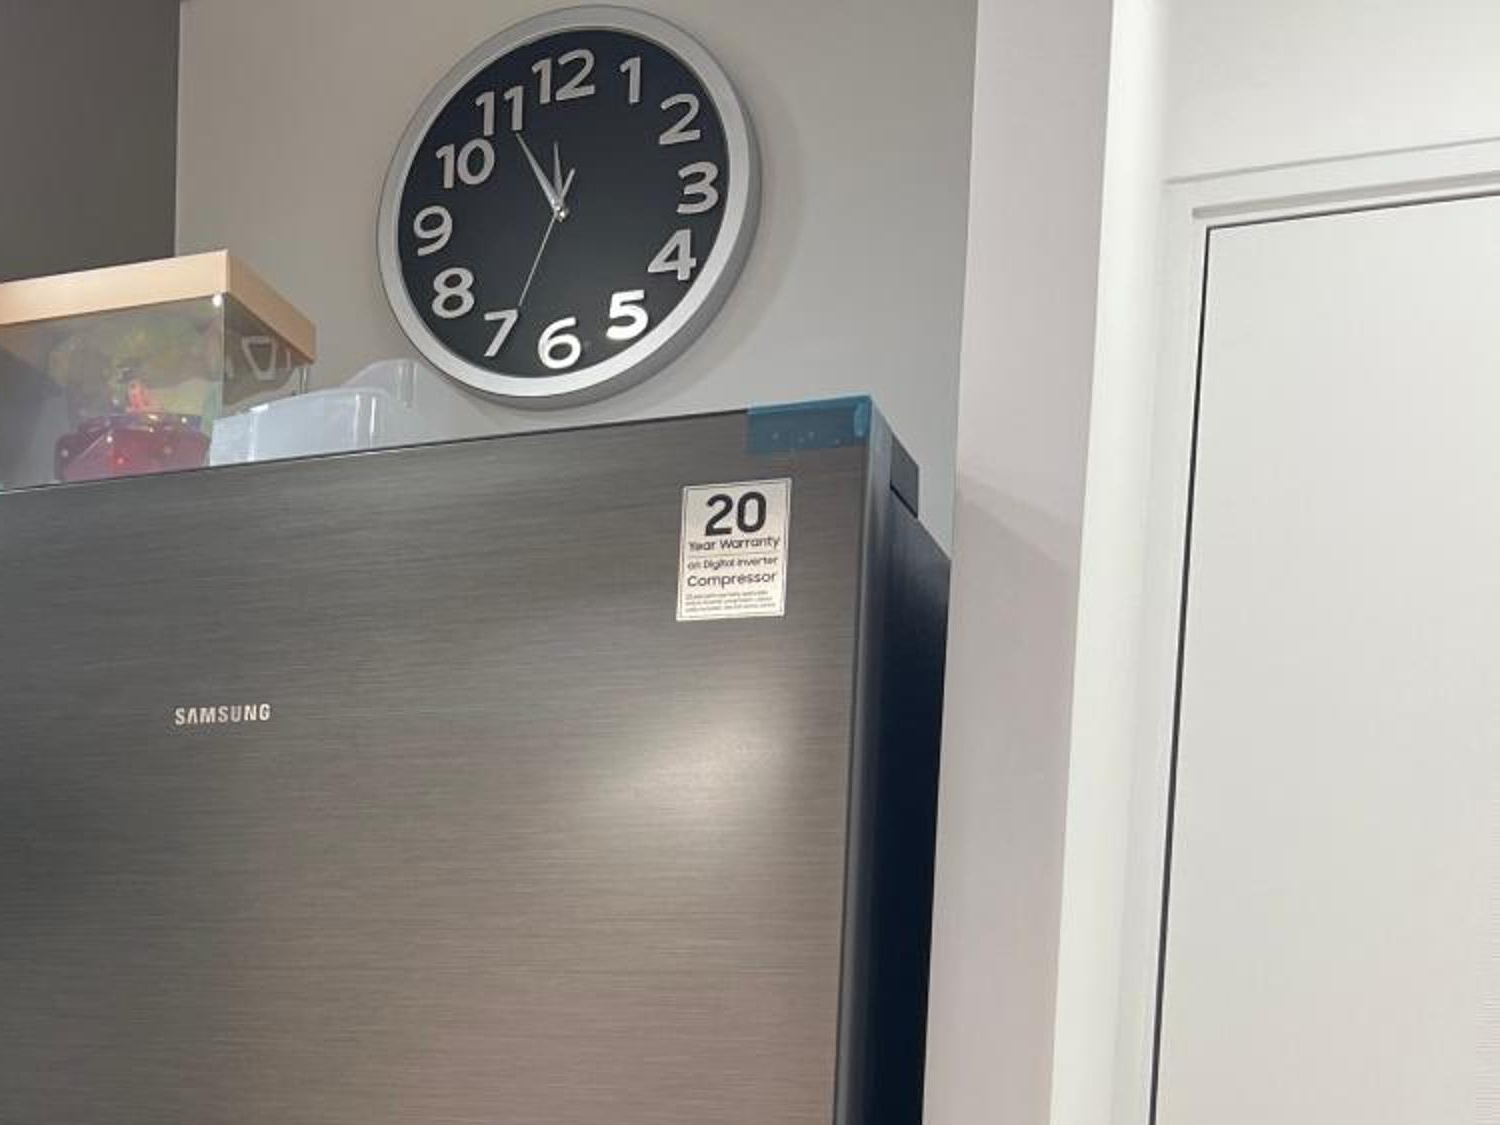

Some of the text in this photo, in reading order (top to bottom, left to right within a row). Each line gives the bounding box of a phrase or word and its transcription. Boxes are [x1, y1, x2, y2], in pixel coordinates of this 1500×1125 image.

[532, 49, 596, 104] 12
[619, 57, 642, 104] 1
[475, 86, 524, 137] 11
[659, 93, 701, 145] 2
[435, 137, 496, 189] 10
[676, 161, 719, 214] 3
[413, 205, 453, 256] 9
[648, 229, 696, 281] 4
[431, 267, 475, 319] 8
[605, 289, 649, 340] 5
[483, 309, 519, 357] 7
[538, 316, 582, 369] 6
[705, 491, 767, 537] 20
[688, 536, 780, 551] Year Warranty
[704, 558, 735, 570] Digital
[737, 557, 778, 568] Inverter
[687, 572, 777, 589] Compressor
[174, 703, 271, 726] SAMSUNG
